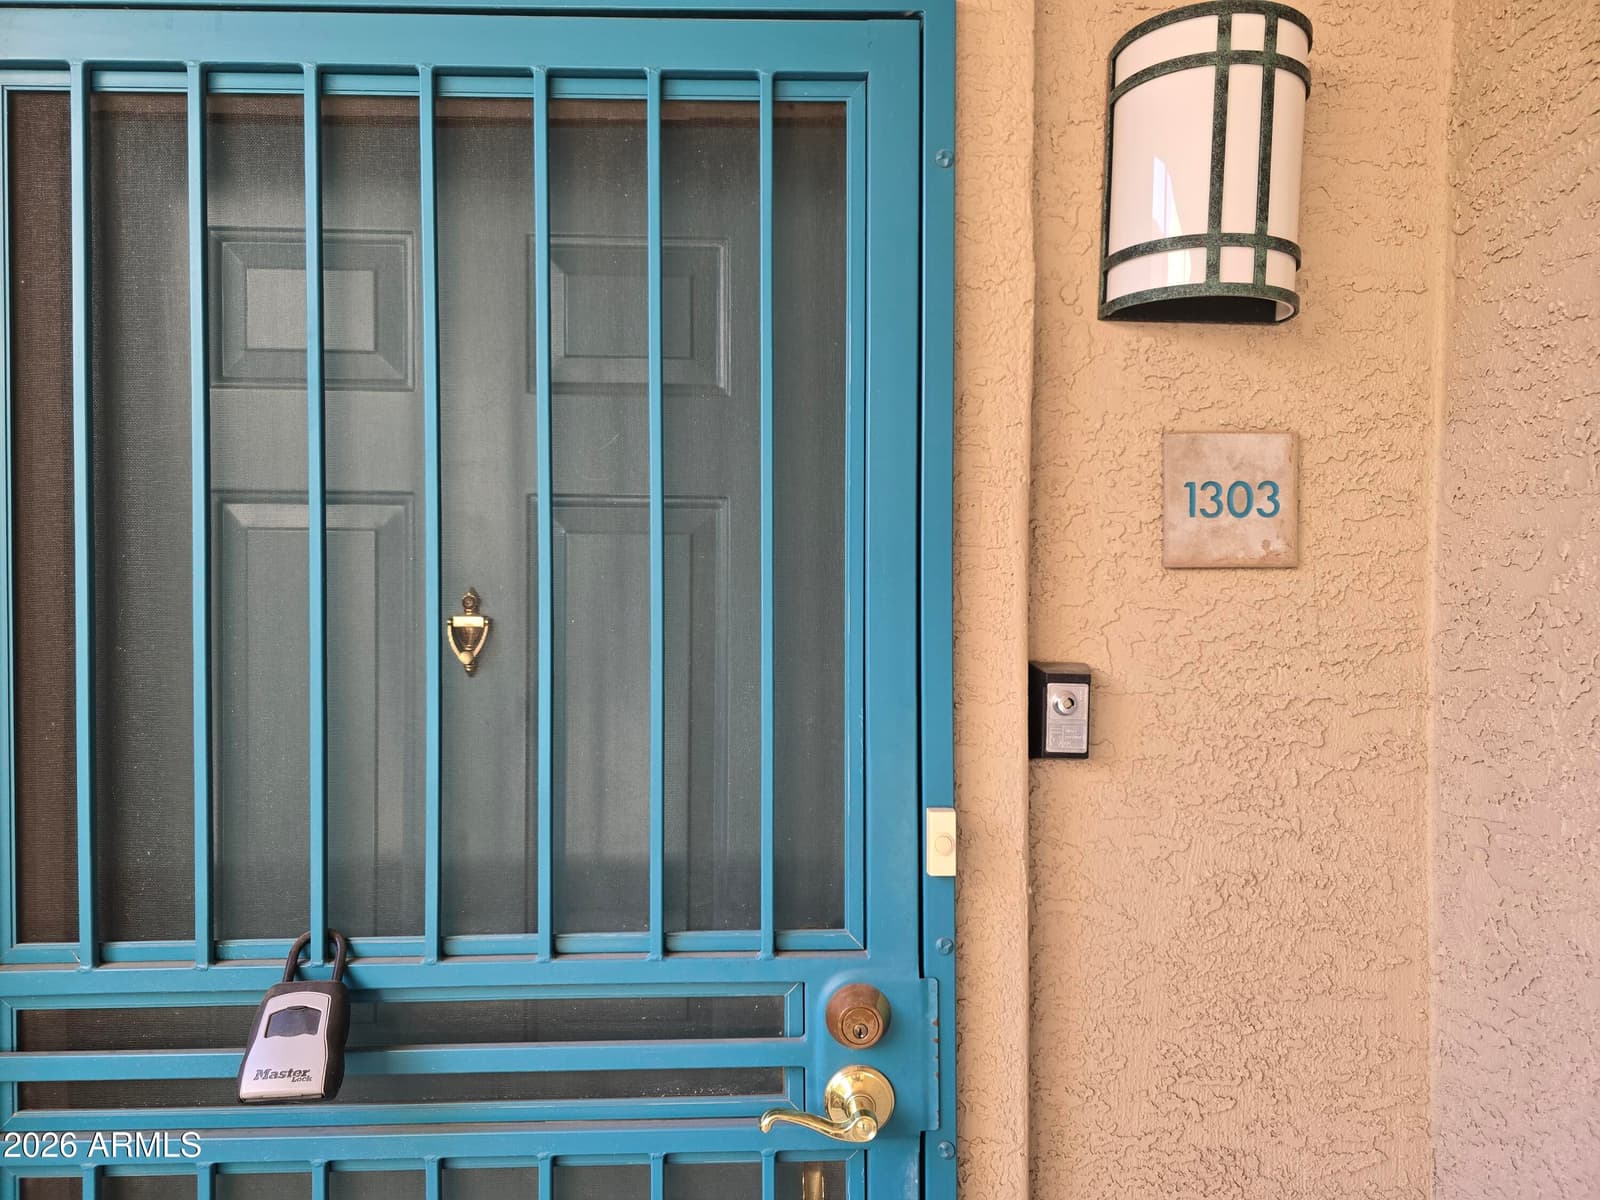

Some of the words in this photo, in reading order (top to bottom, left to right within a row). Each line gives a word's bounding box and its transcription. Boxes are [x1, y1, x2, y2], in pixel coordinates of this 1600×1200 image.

[1184, 481, 1281, 518] 1303
[253, 1067, 311, 1081] Master
[291, 1075, 312, 1083] Lock
